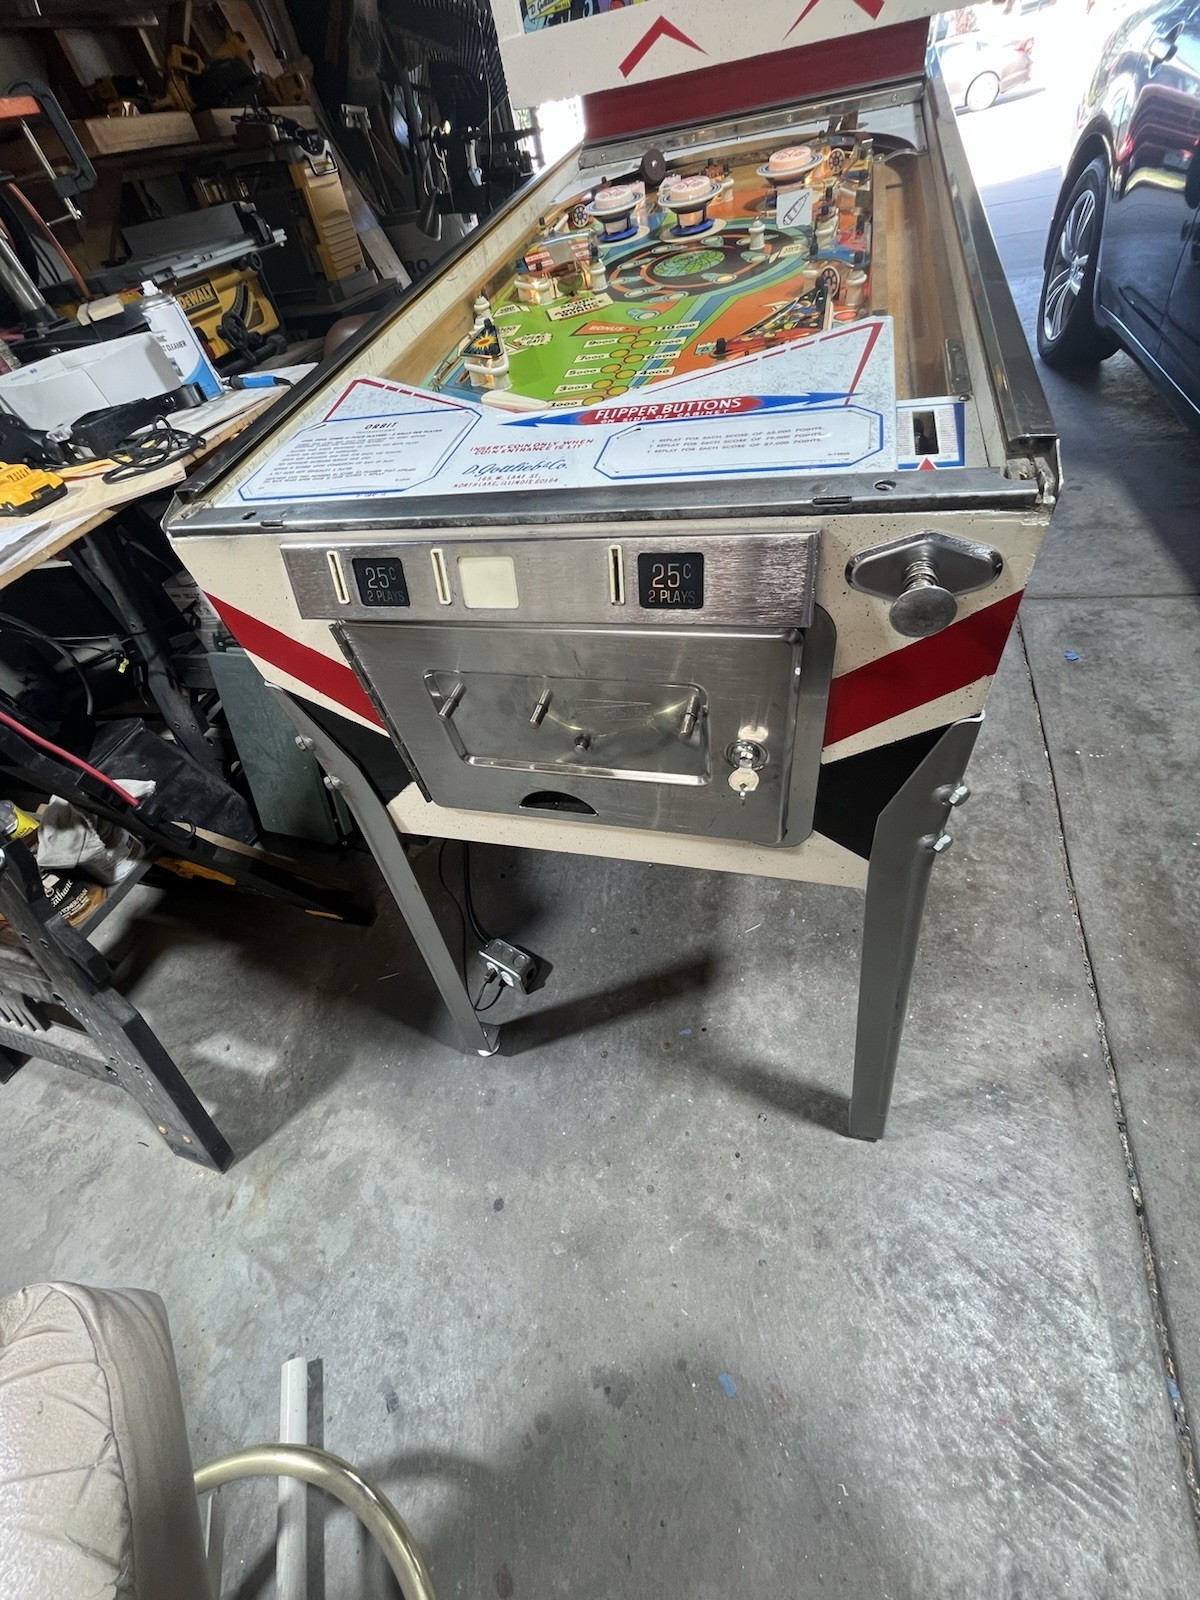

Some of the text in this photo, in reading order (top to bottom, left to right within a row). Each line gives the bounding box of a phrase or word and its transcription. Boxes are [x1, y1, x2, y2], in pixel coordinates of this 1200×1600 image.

[166, 340, 188, 351] CLEANER
[646, 352, 677, 360] 6000
[559, 384, 588, 392] 3000
[594, 397, 742, 420] FLIPPER BUTTONS
[676, 409, 729, 418] CABINET
[364, 421, 399, 430] ORBIT
[470, 444, 507, 452] INSERT
[367, 590, 405, 603] 2 PLAYS
[648, 589, 696, 604] 2 PLAYS
